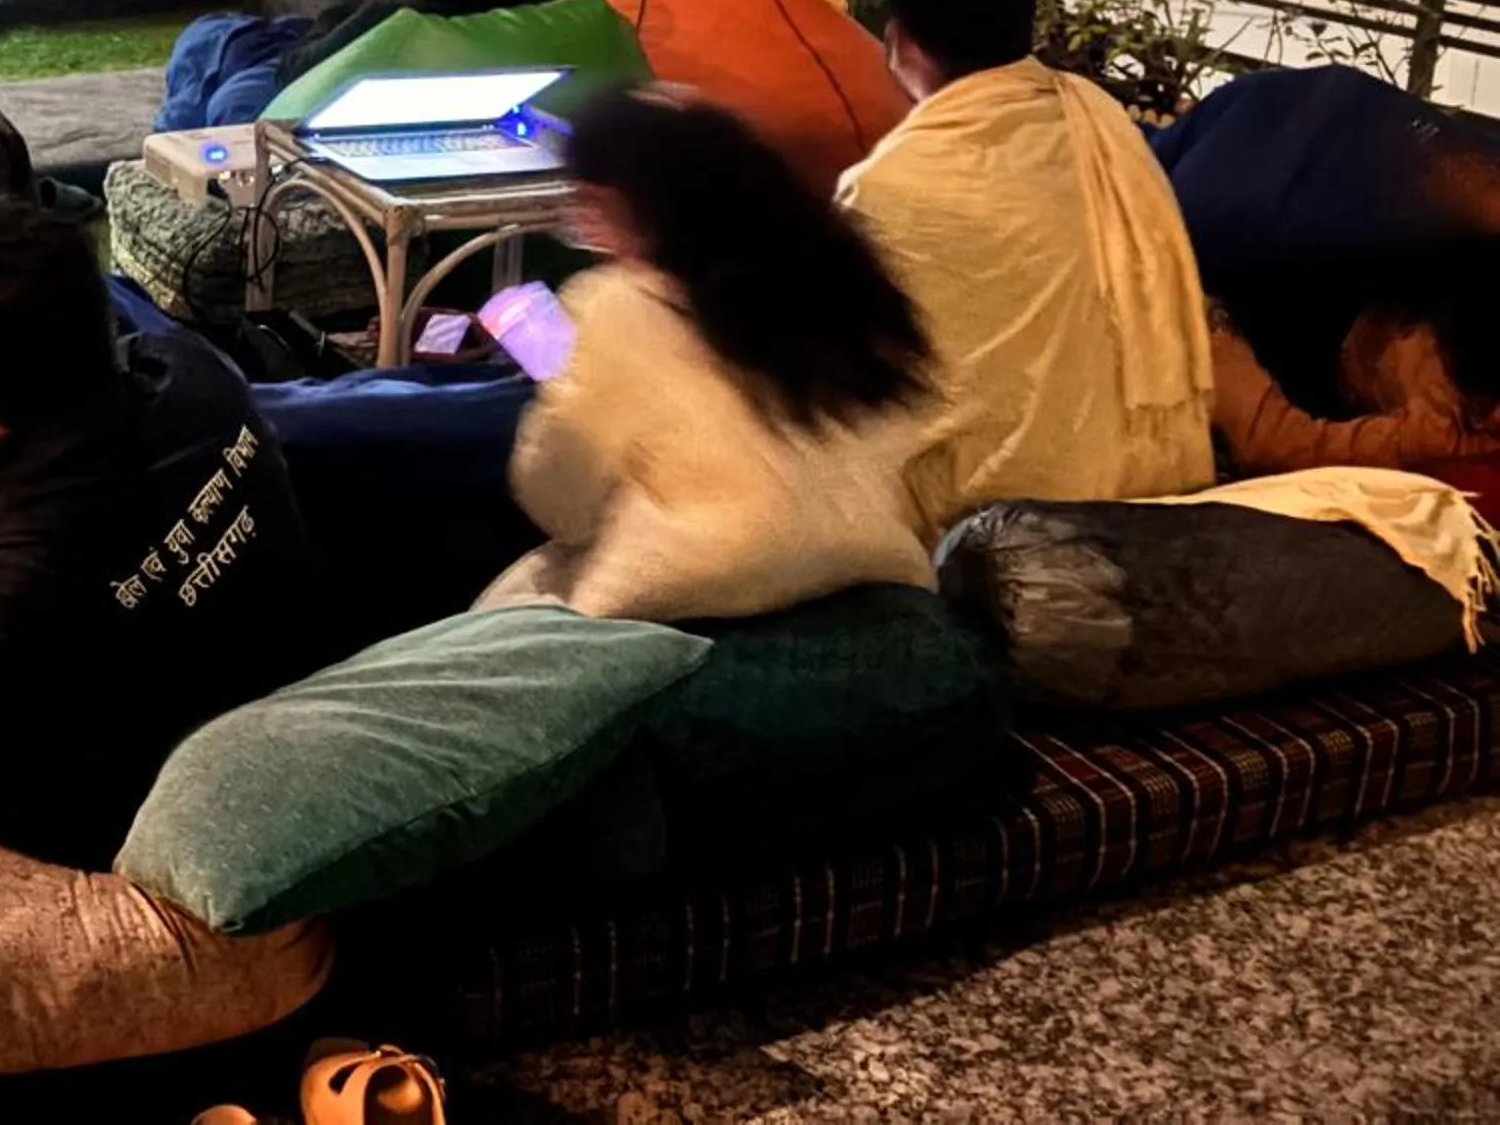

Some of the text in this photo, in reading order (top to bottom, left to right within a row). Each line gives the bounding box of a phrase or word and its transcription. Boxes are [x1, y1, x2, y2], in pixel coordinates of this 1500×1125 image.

[110, 424, 259, 608] खेल एवं युवा कल्याण विभाग
[178, 504, 257, 607] छत्तीसगढ़
